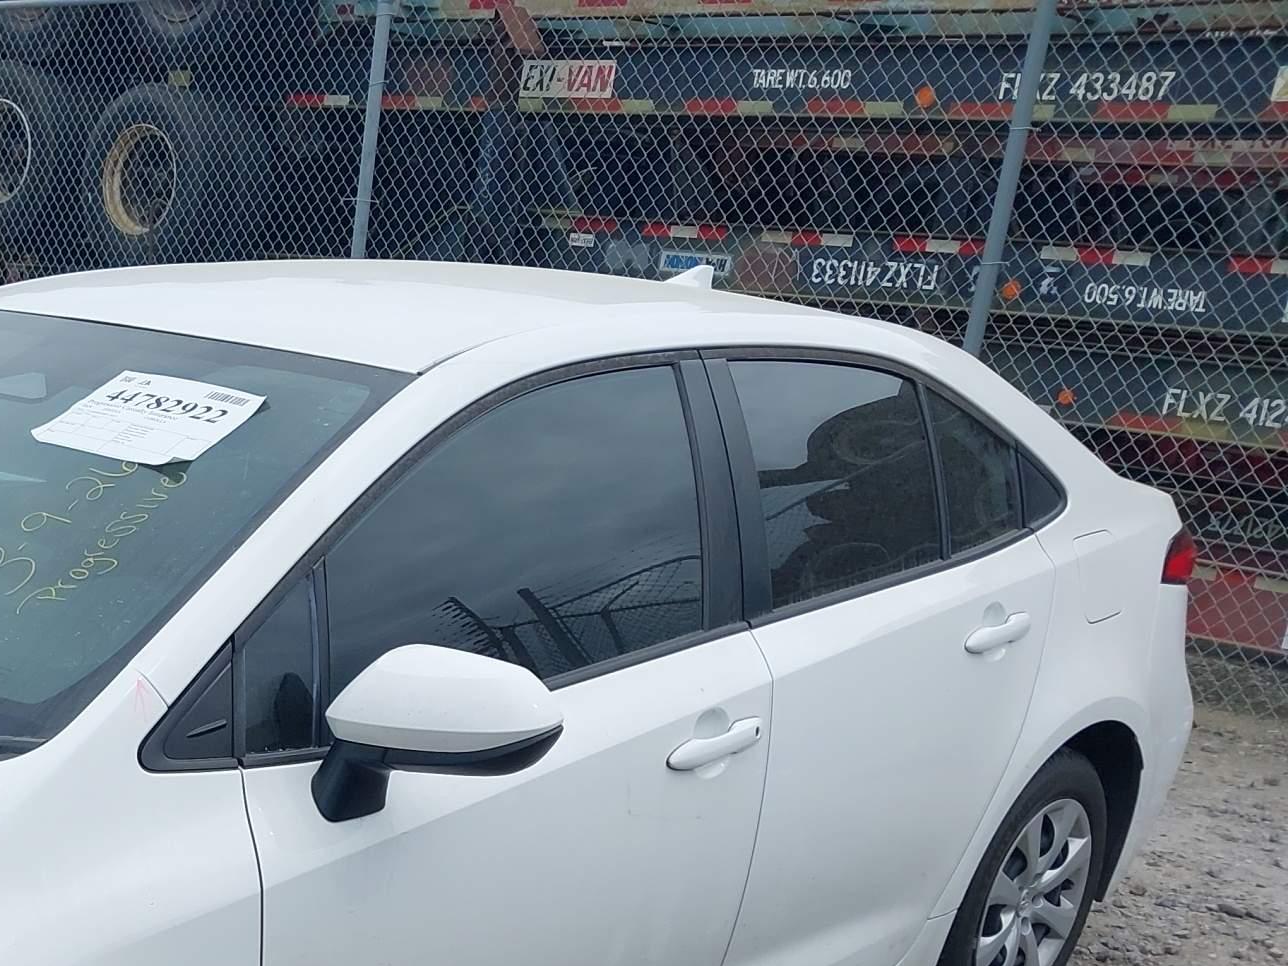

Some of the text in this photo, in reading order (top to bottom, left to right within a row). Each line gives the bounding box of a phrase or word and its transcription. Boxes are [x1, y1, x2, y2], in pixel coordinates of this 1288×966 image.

[1069, 71, 1176, 101] 433487
[811, 258, 940, 290] FLXZ 411333
[104, 388, 230, 425] 44782922
[1162, 388, 1288, 429] FLXZ 412
